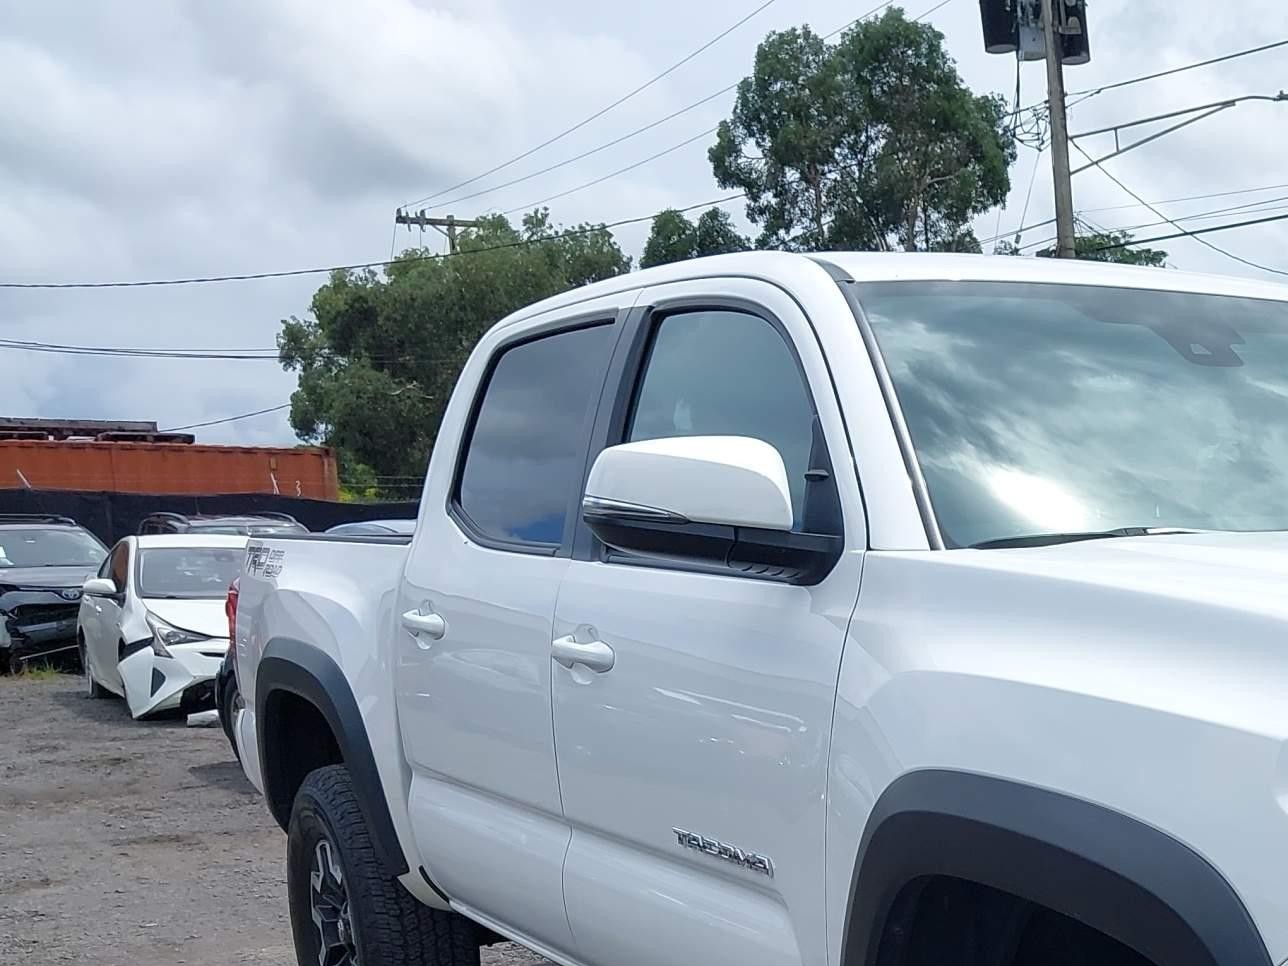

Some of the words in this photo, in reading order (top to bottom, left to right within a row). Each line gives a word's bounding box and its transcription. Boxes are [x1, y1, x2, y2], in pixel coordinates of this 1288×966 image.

[246, 546, 270, 576] TRD
[269, 549, 285, 561] OFF
[264, 563, 283, 577] ROAD
[672, 825, 775, 879] TACOMA
